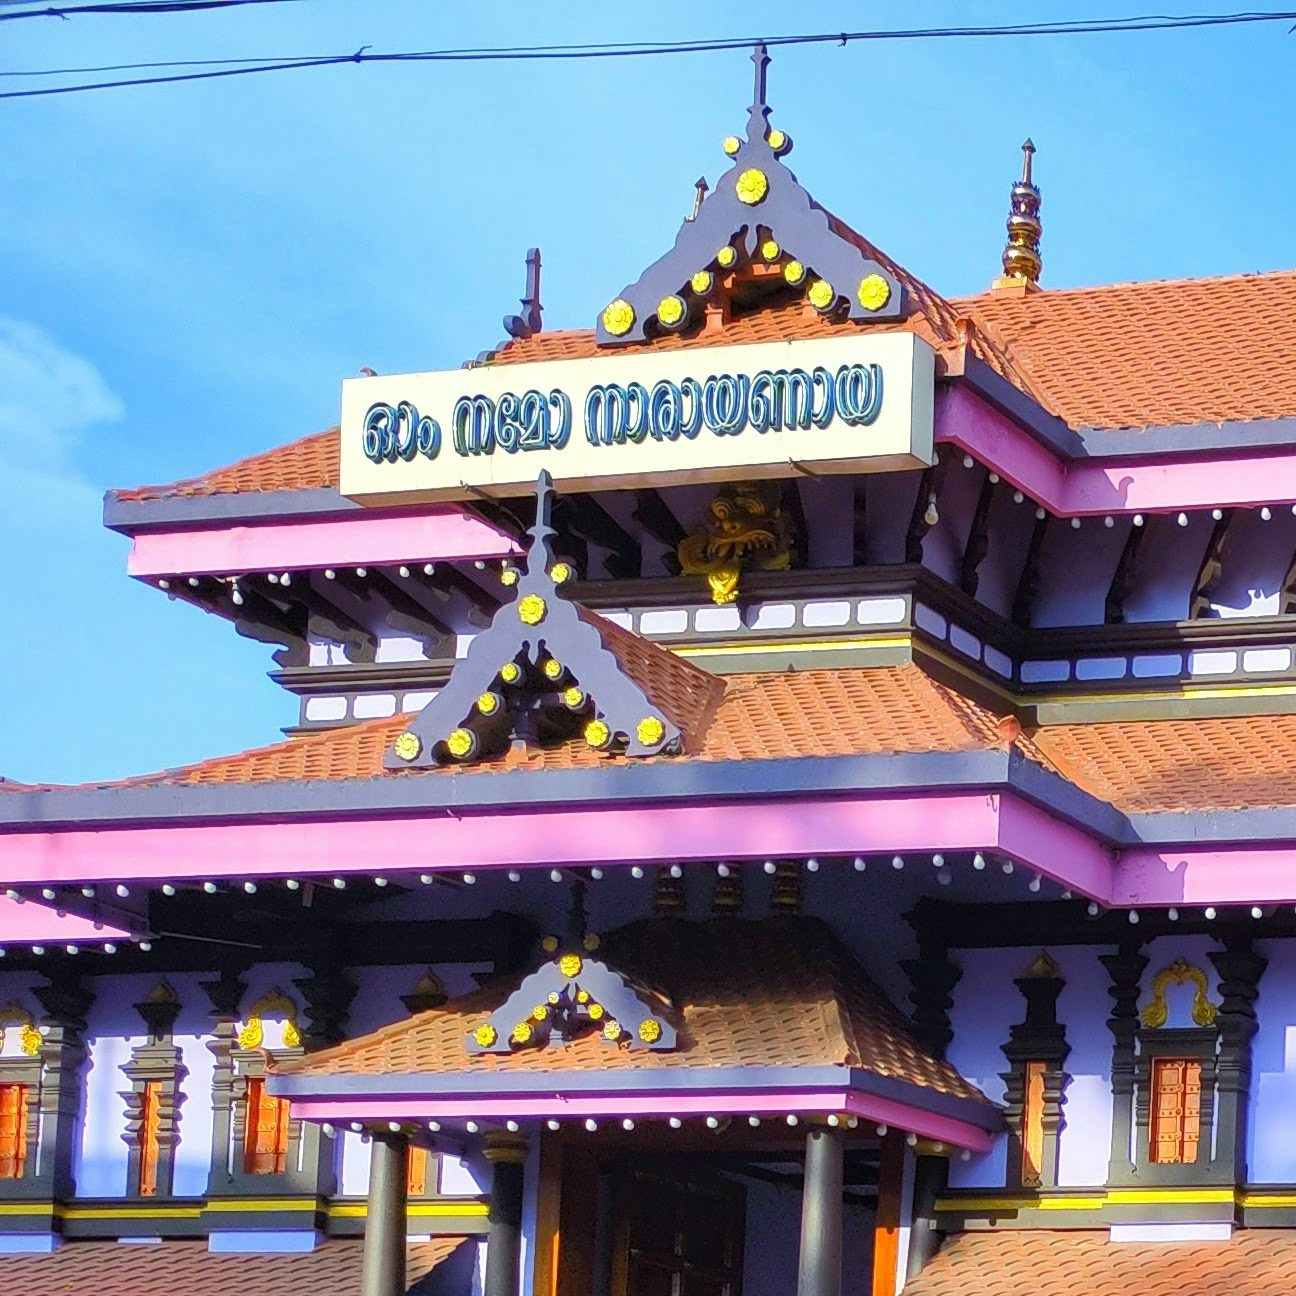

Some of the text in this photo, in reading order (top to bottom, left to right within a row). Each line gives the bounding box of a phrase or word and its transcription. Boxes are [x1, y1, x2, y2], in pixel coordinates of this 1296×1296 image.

[363, 362, 884, 464] ഓം നമോ നാരായണായ
